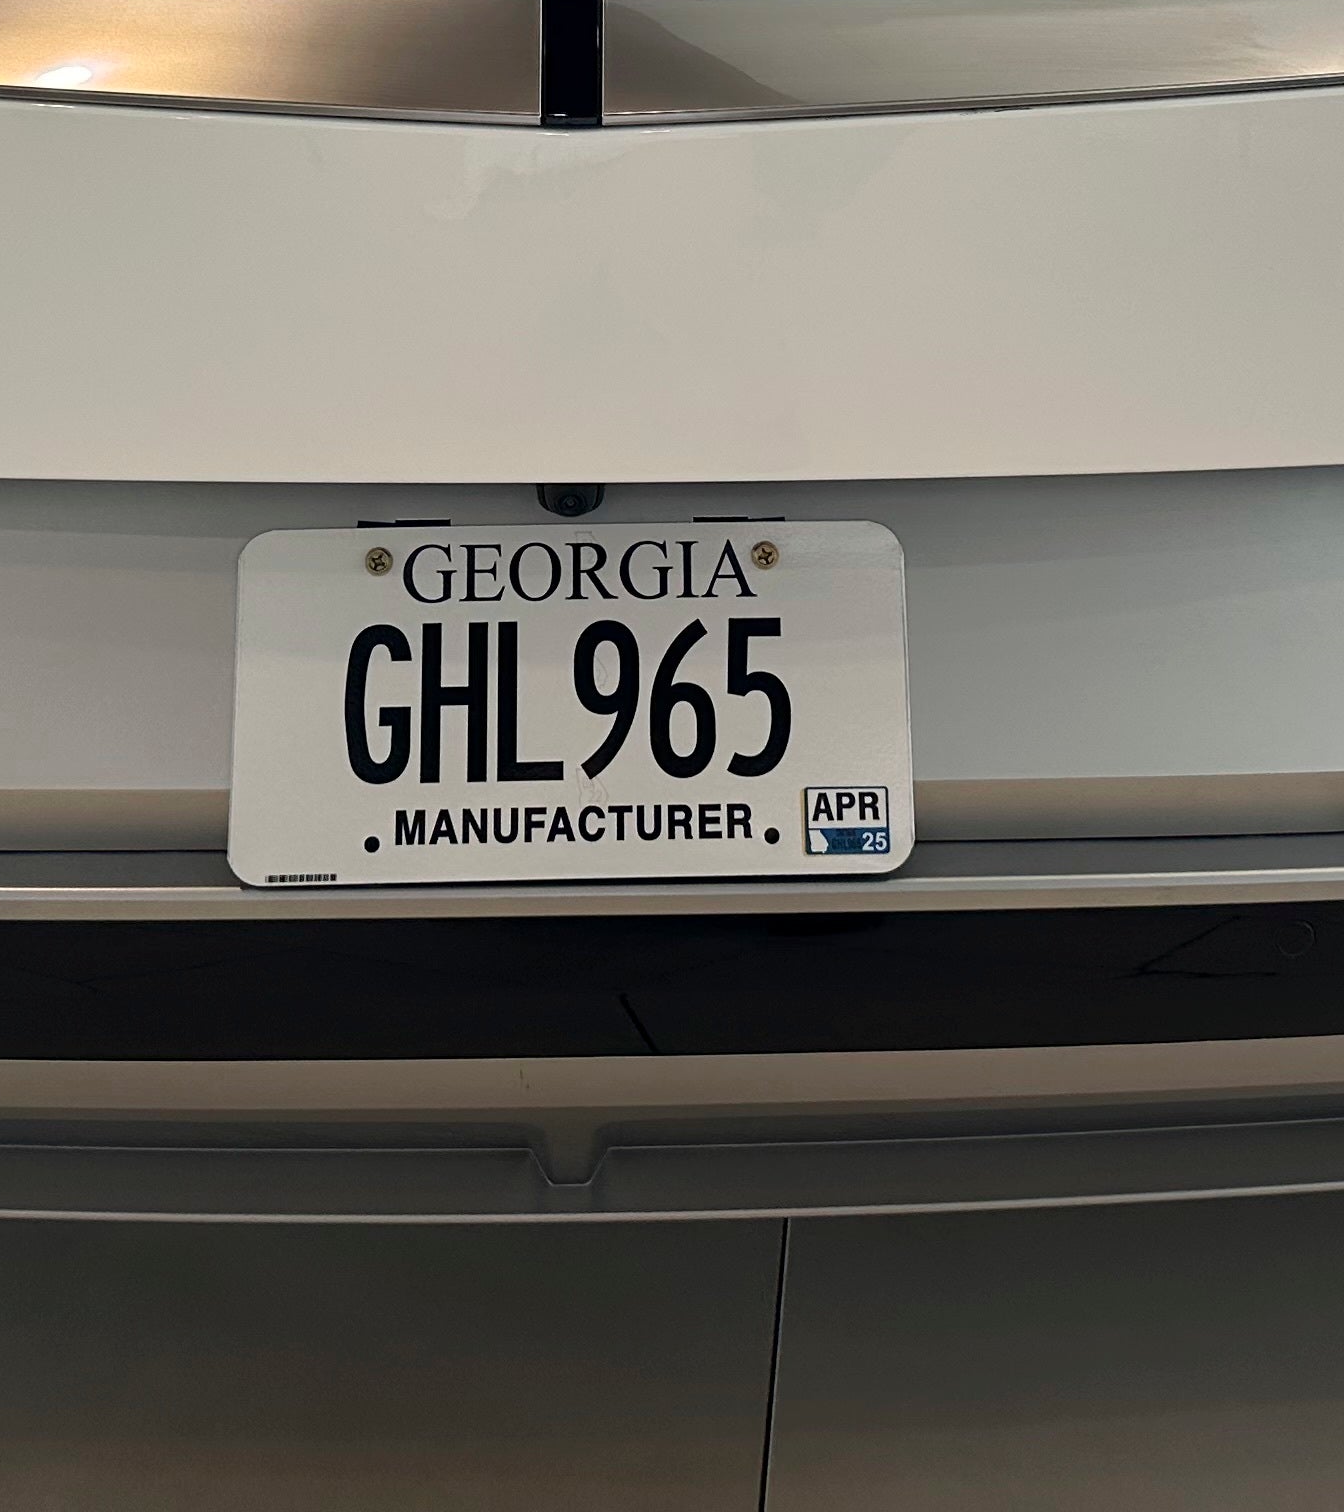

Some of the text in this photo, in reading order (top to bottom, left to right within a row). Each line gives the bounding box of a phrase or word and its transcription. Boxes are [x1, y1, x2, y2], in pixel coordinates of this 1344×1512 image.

[403, 539, 757, 604] GEORGIA
[812, 791, 880, 821] APR
[394, 803, 753, 847] MANUFACTURER
[862, 831, 888, 851] 25
